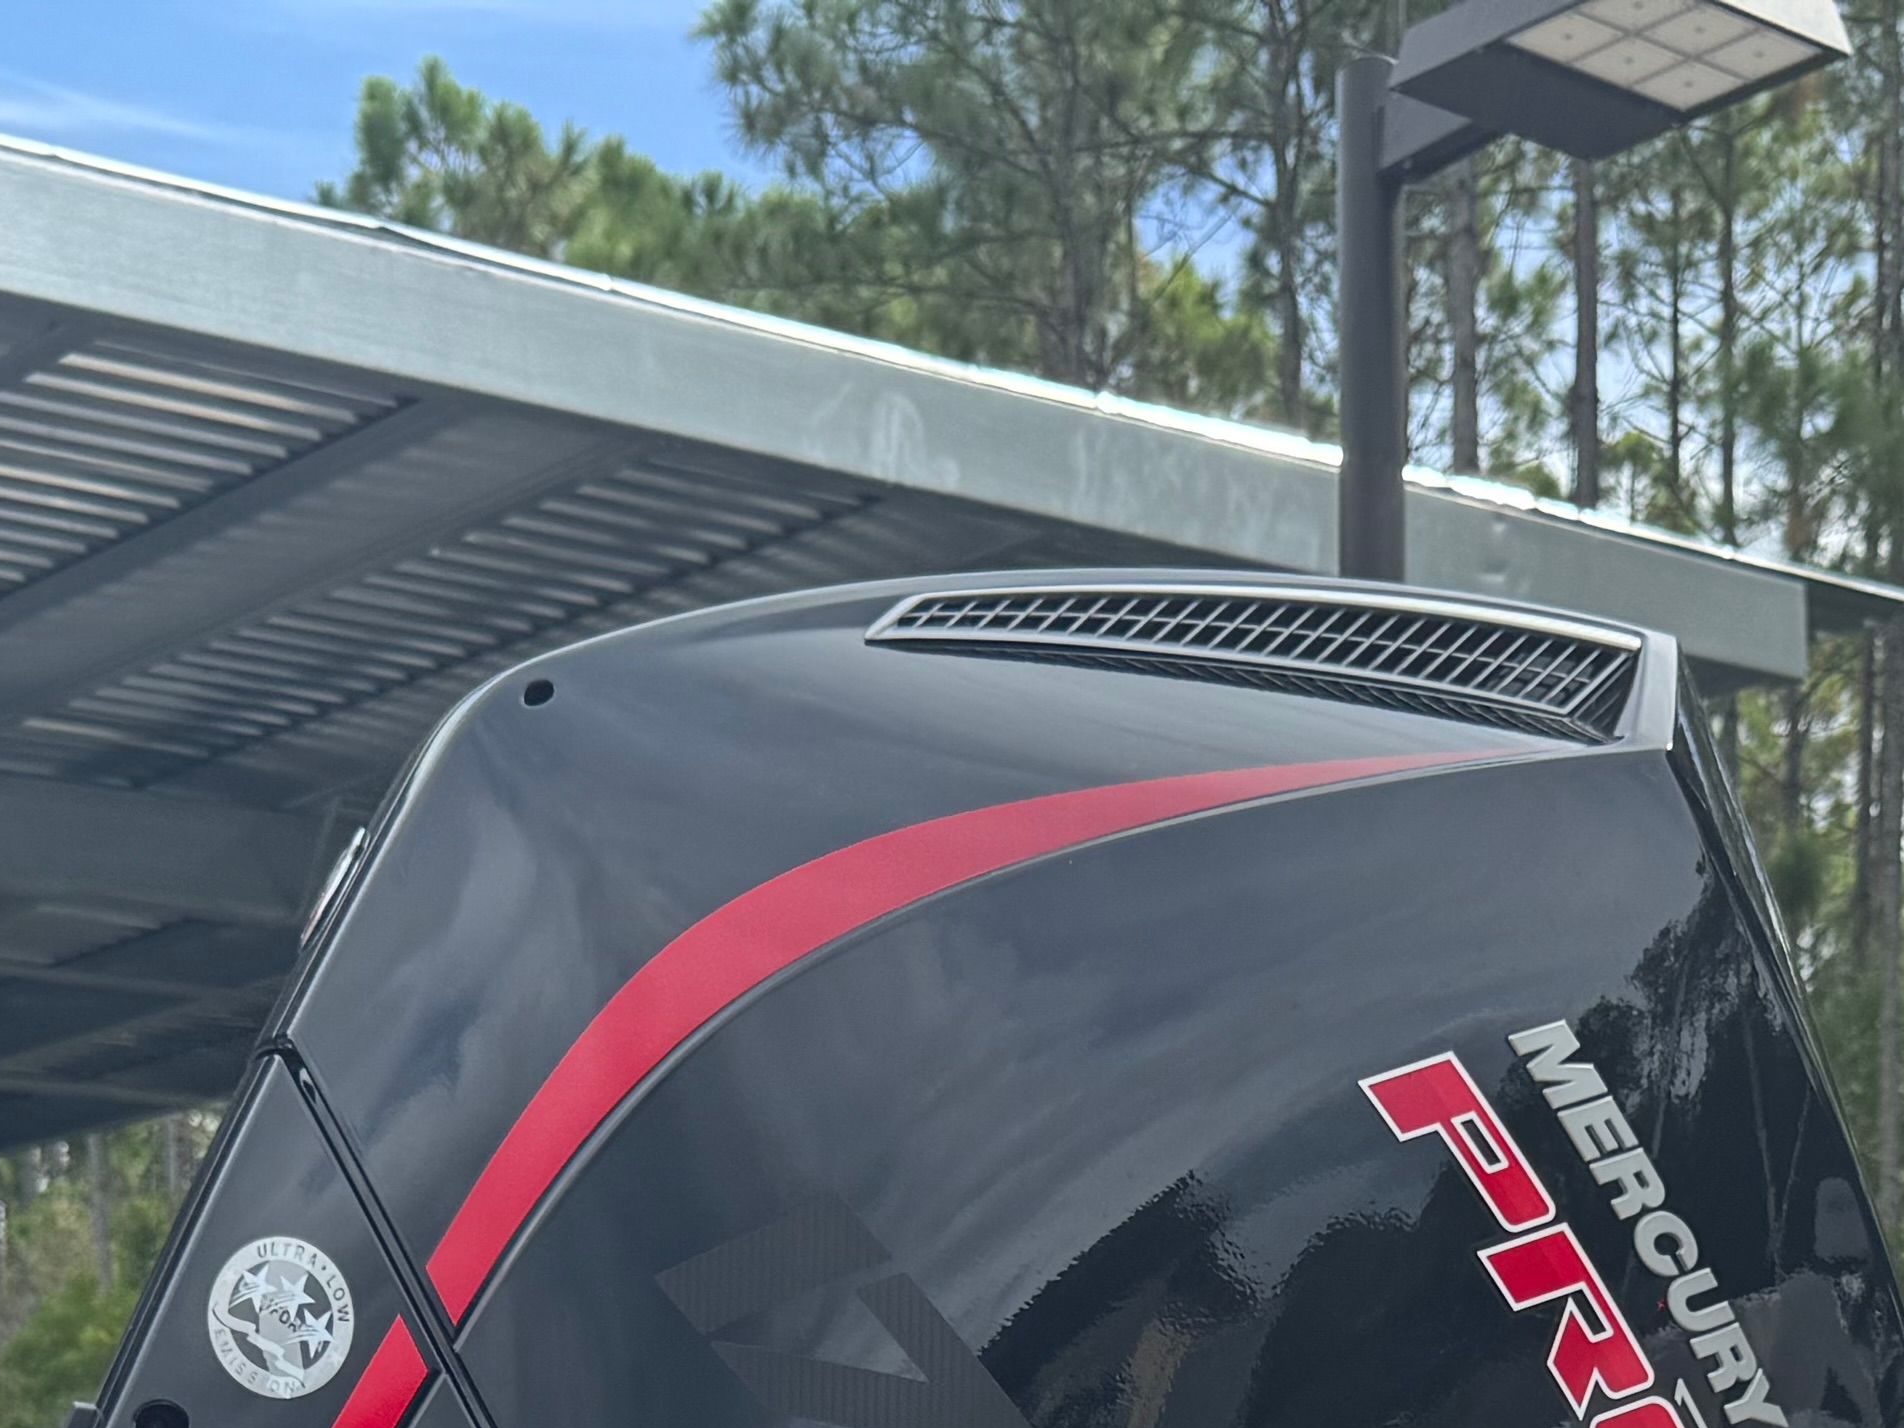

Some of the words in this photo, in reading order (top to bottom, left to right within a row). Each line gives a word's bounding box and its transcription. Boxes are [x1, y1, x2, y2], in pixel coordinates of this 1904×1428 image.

[257, 1241, 318, 1269] ULTRA
[327, 1276, 350, 1322] LOW
[214, 1329, 301, 1393] EMISSON
